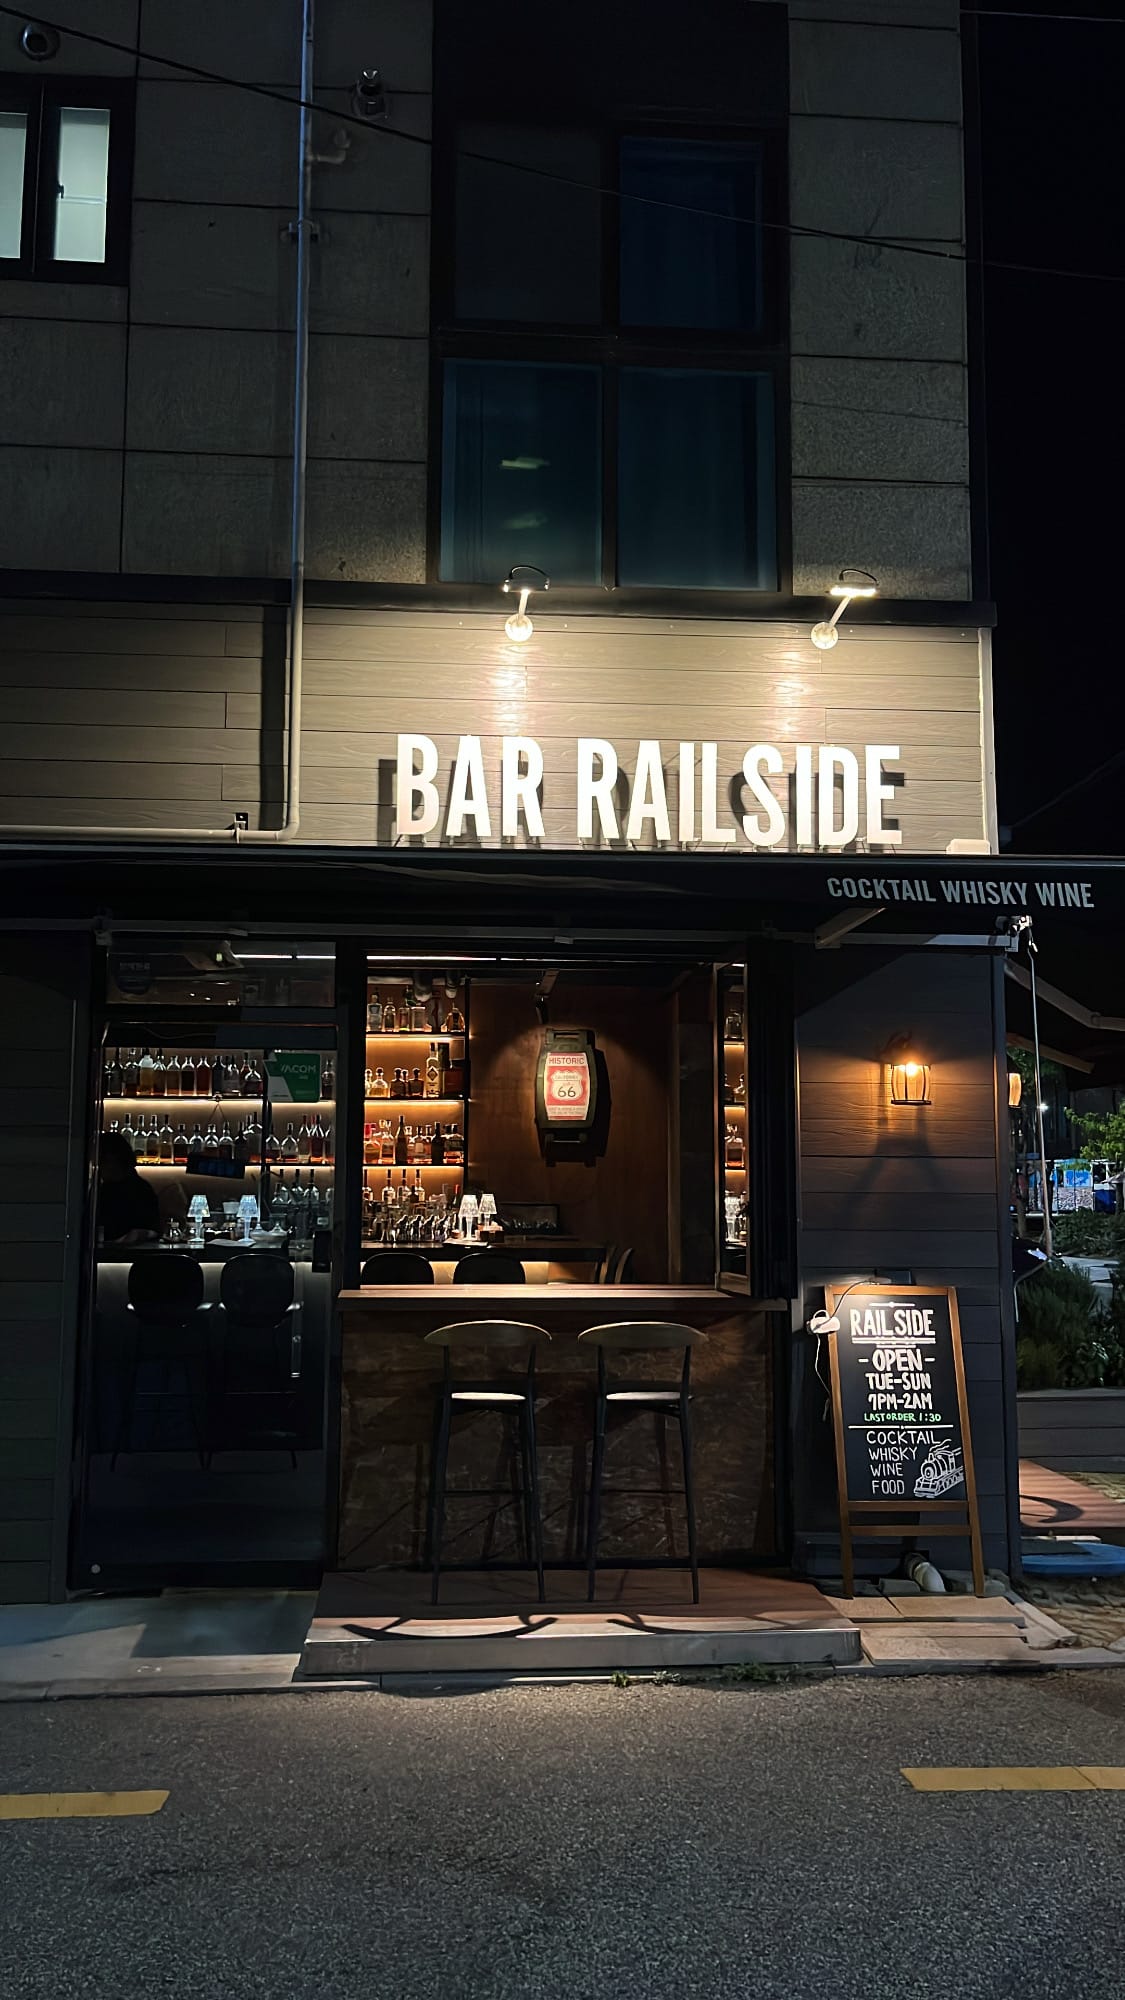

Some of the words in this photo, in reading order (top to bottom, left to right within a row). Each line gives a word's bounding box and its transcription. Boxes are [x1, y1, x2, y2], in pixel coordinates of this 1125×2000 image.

[396, 734, 546, 838] BAR
[577, 738, 902, 847] RAILSIDE
[826, 877, 937, 902] COCKTAIL
[940, 880, 1028, 906] WHISKY
[1035, 882, 1095, 908] WINE
[558, 1086, 577, 1097] 66
[865, 1371, 932, 1391] TUE-SUN
[867, 1392, 933, 1411] 7PM-2AM
[919, 1412, 942, 1422] 1:30
[866, 1430, 941, 1445] COCKTAIL
[868, 1446, 918, 1462] WHISKY
[869, 1462, 904, 1477] WINE
[871, 1479, 905, 1495] FOOD
